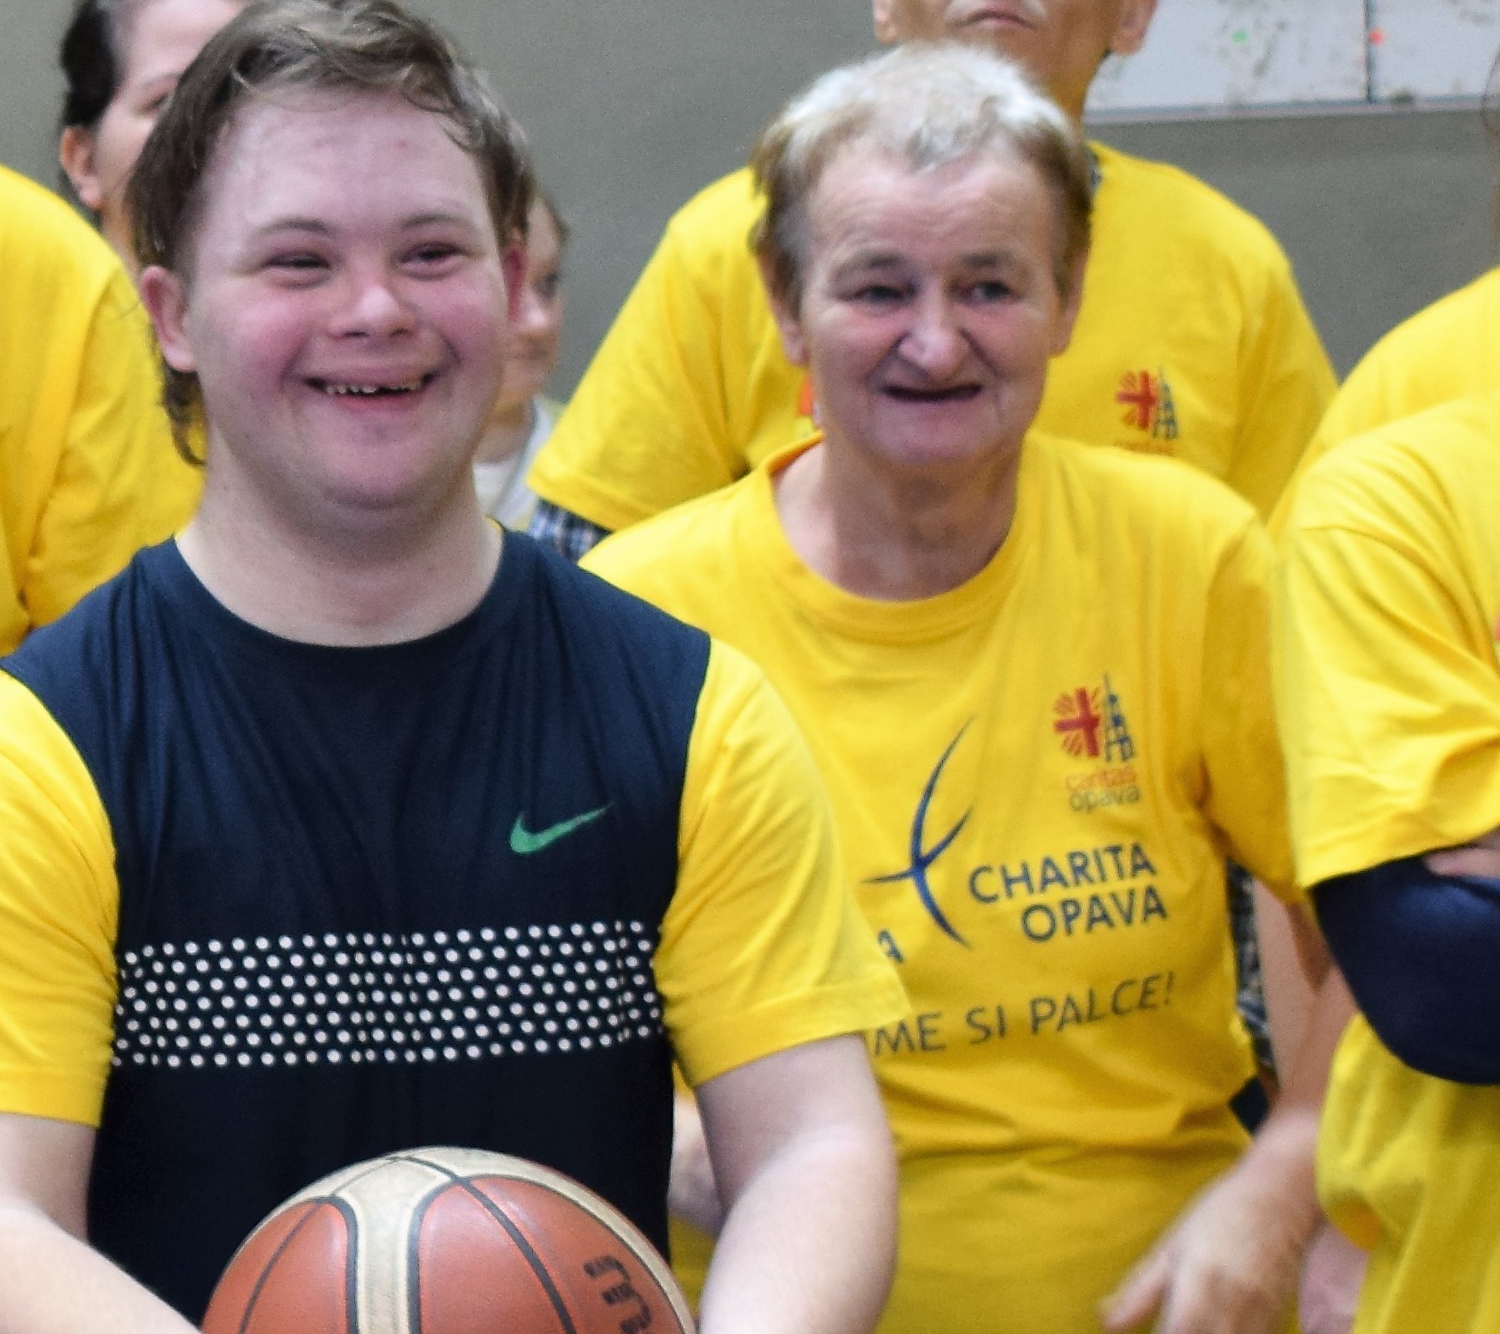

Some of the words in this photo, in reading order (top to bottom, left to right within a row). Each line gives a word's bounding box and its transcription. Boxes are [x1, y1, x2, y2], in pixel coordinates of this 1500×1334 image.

[969, 841, 1157, 904] CHARITA
[1021, 884, 1169, 942] OPAVA
[966, 1005, 1007, 1045] SI
[1030, 971, 1176, 1037] PALCE!
